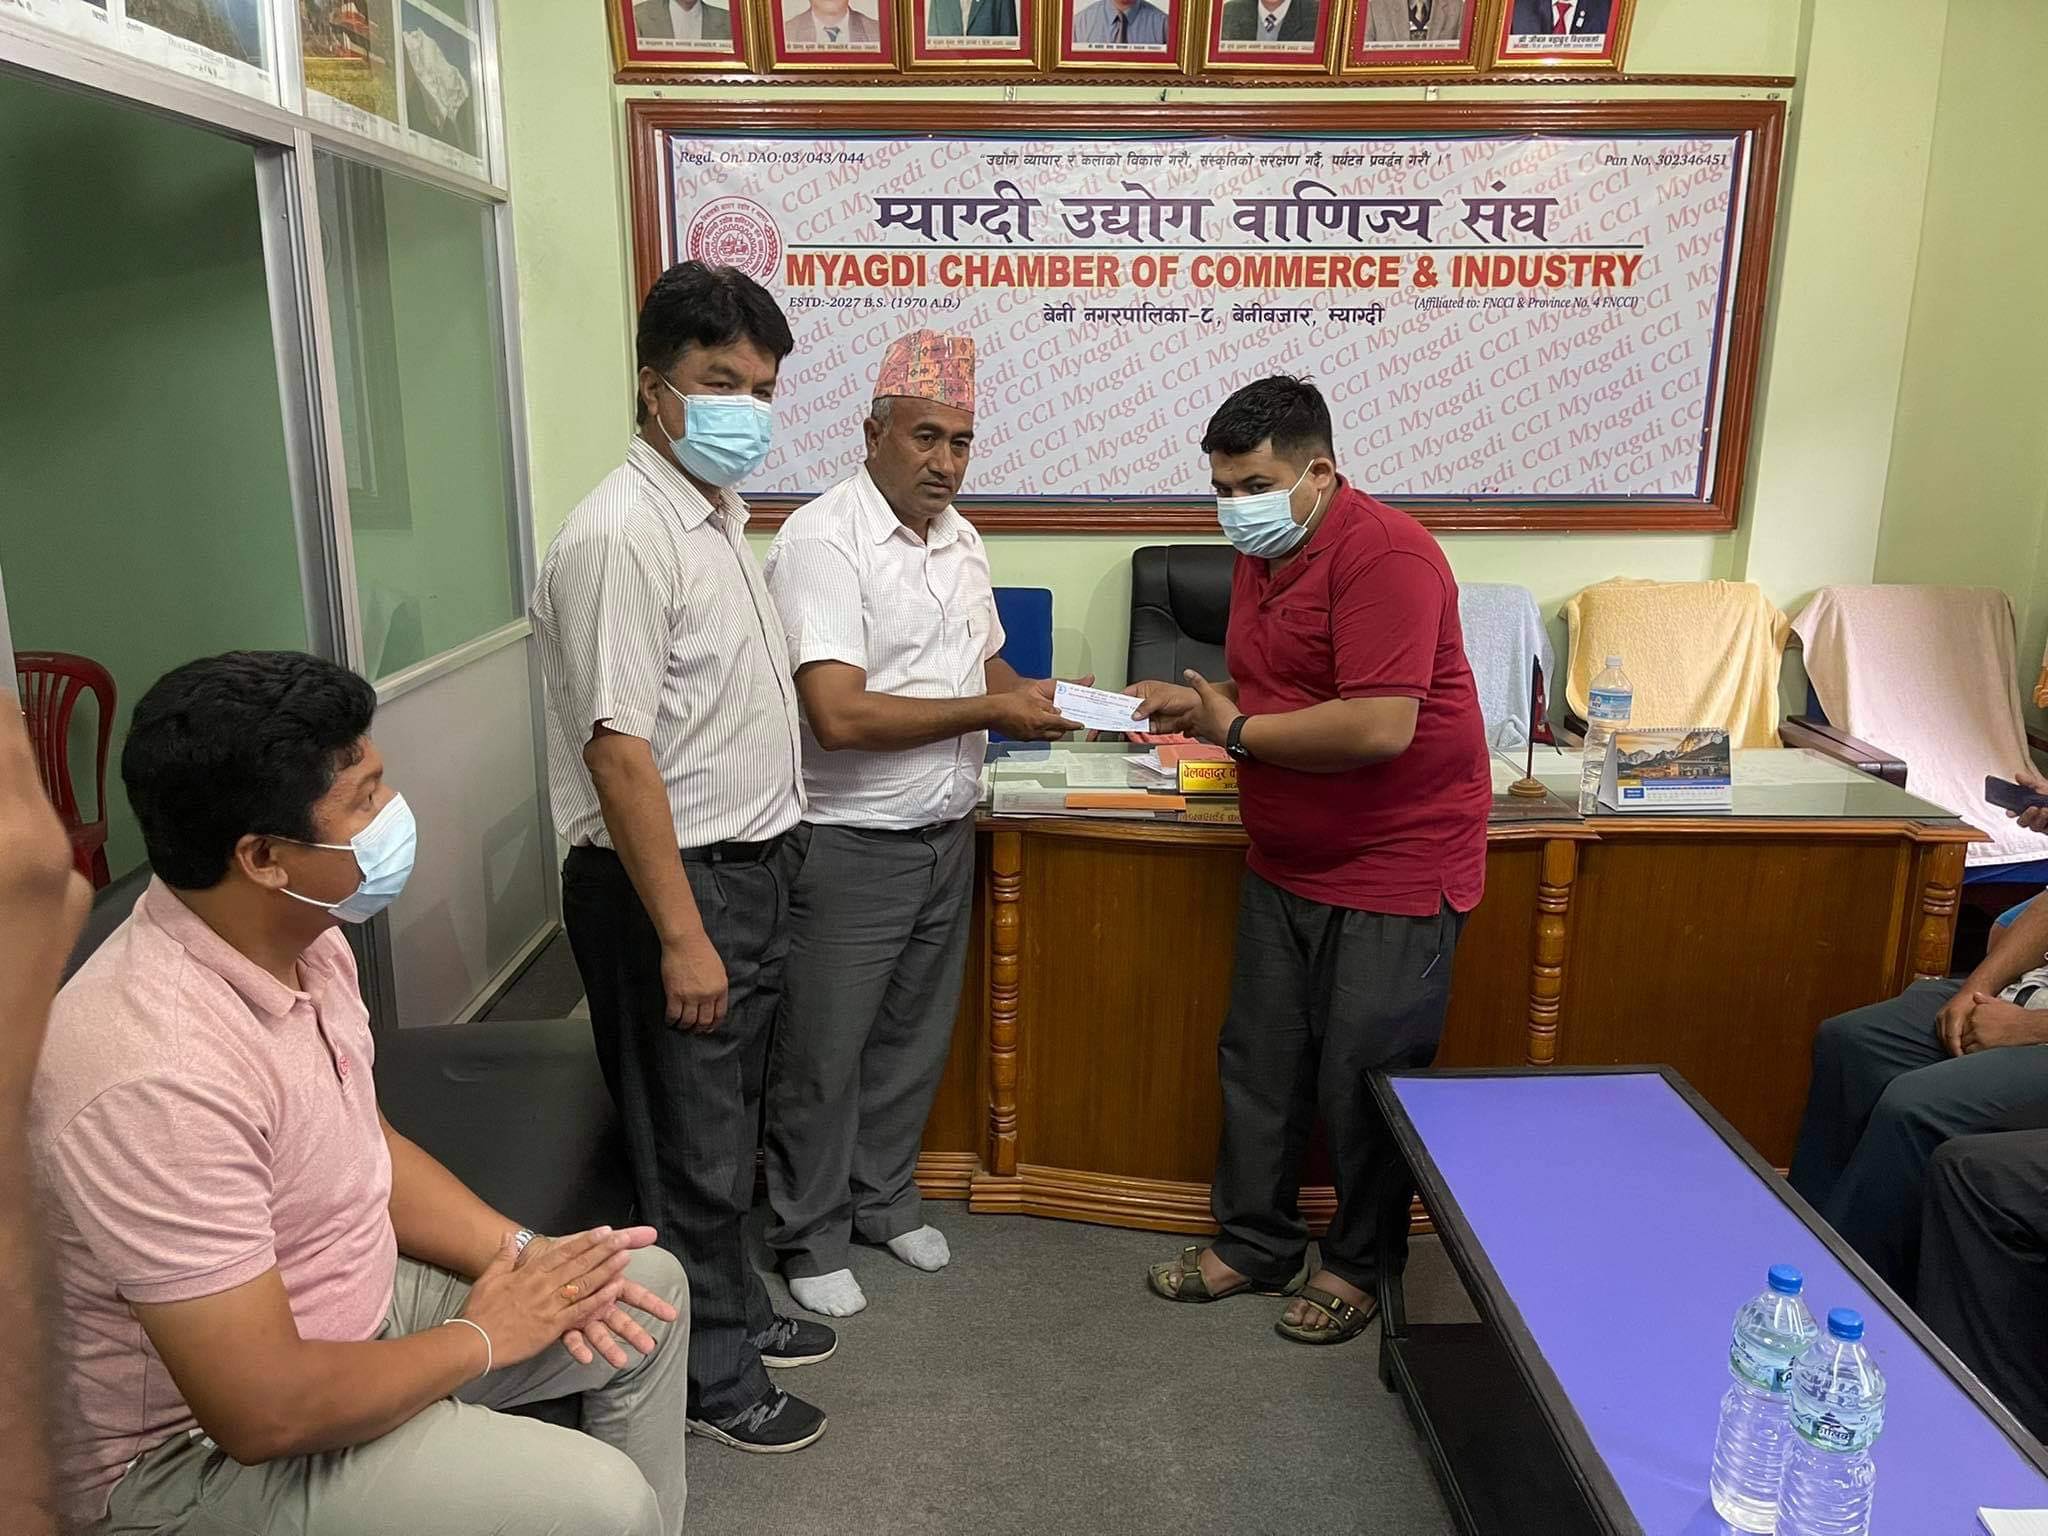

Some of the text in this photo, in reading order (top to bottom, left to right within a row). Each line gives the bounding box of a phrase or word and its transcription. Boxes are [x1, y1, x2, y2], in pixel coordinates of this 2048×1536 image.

[680, 151, 865, 165] Regd. On. DAO:03/043/044
[1588, 168, 1632, 204] CCI
[1605, 154, 1728, 166] Pan No. 302346451
[781, 178, 823, 213] CCI
[873, 180, 1042, 243] म्याग्दी
[1059, 180, 1216, 243] उद्योग
[1232, 180, 1443, 243] वाणिज्य
[1460, 180, 1559, 243] संघ
[1600, 197, 1643, 232] CCI
[796, 207, 839, 242] CCI
[786, 254, 1644, 288] MYAGDI CHAMBER OF COMMERCE & INDUSTRY
[788, 296, 961, 311] ESTD:-2027 B.S. (1970 A.D.)
[1043, 302, 1076, 324] बेनी
[1328, 302, 1385, 327] म्याग्दी
[1414, 296, 1465, 311] (Affiliated
[1466, 298, 1480, 309] to:
[1482, 297, 1515, 309] FNCCI
[1527, 296, 1571, 309] Province
[1573, 297, 1590, 308] No.
[1591, 297, 1600, 308] 4
[852, 321, 891, 355] CCI
[1023, 336, 1062, 370] CCI
[1050, 326, 1133, 384] Myagdi
[1320, 341, 1361, 376] CCI
[1331, 369, 1371, 403] CCI
[1376, 323, 1463, 382] Myagdi
[1005, 371, 1044, 405] CCI
[1062, 352, 1145, 411] Myagdi
[1150, 328, 1191, 363] CCI
[1018, 399, 1056, 432] CCI
[1073, 380, 1158, 437] Myagdi
[1162, 356, 1201, 391] CCI
[1343, 397, 1383, 430] CCI
[1388, 350, 1475, 409] Myagdi
[1480, 326, 1521, 361] CCI
[1353, 425, 1393, 457] CCI
[1399, 379, 1486, 437] Myagdi
[1490, 355, 1531, 388] CCI
[1536, 308, 1625, 367] Myagdi
[1364, 311, 1683, 484] CCI Myagdi CCI Myagdi CCI
[777, 373, 861, 430] Myagdi
[1030, 425, 1070, 459] CCI
[1085, 408, 1169, 465] Myagdi
[1174, 383, 1215, 418] CCI
[1421, 338, 1694, 489] Myagdi CCI Myagdi CCI
[1522, 436, 1563, 469] CCI
[1567, 390, 1656, 448] Myagdi
[1661, 366, 1704, 400] CCI
[1042, 453, 1082, 485] CCI
[1097, 434, 1181, 491] Myagdi
[1578, 418, 1665, 475] Myagdi
[1614, 452, 1655, 483] CCI
